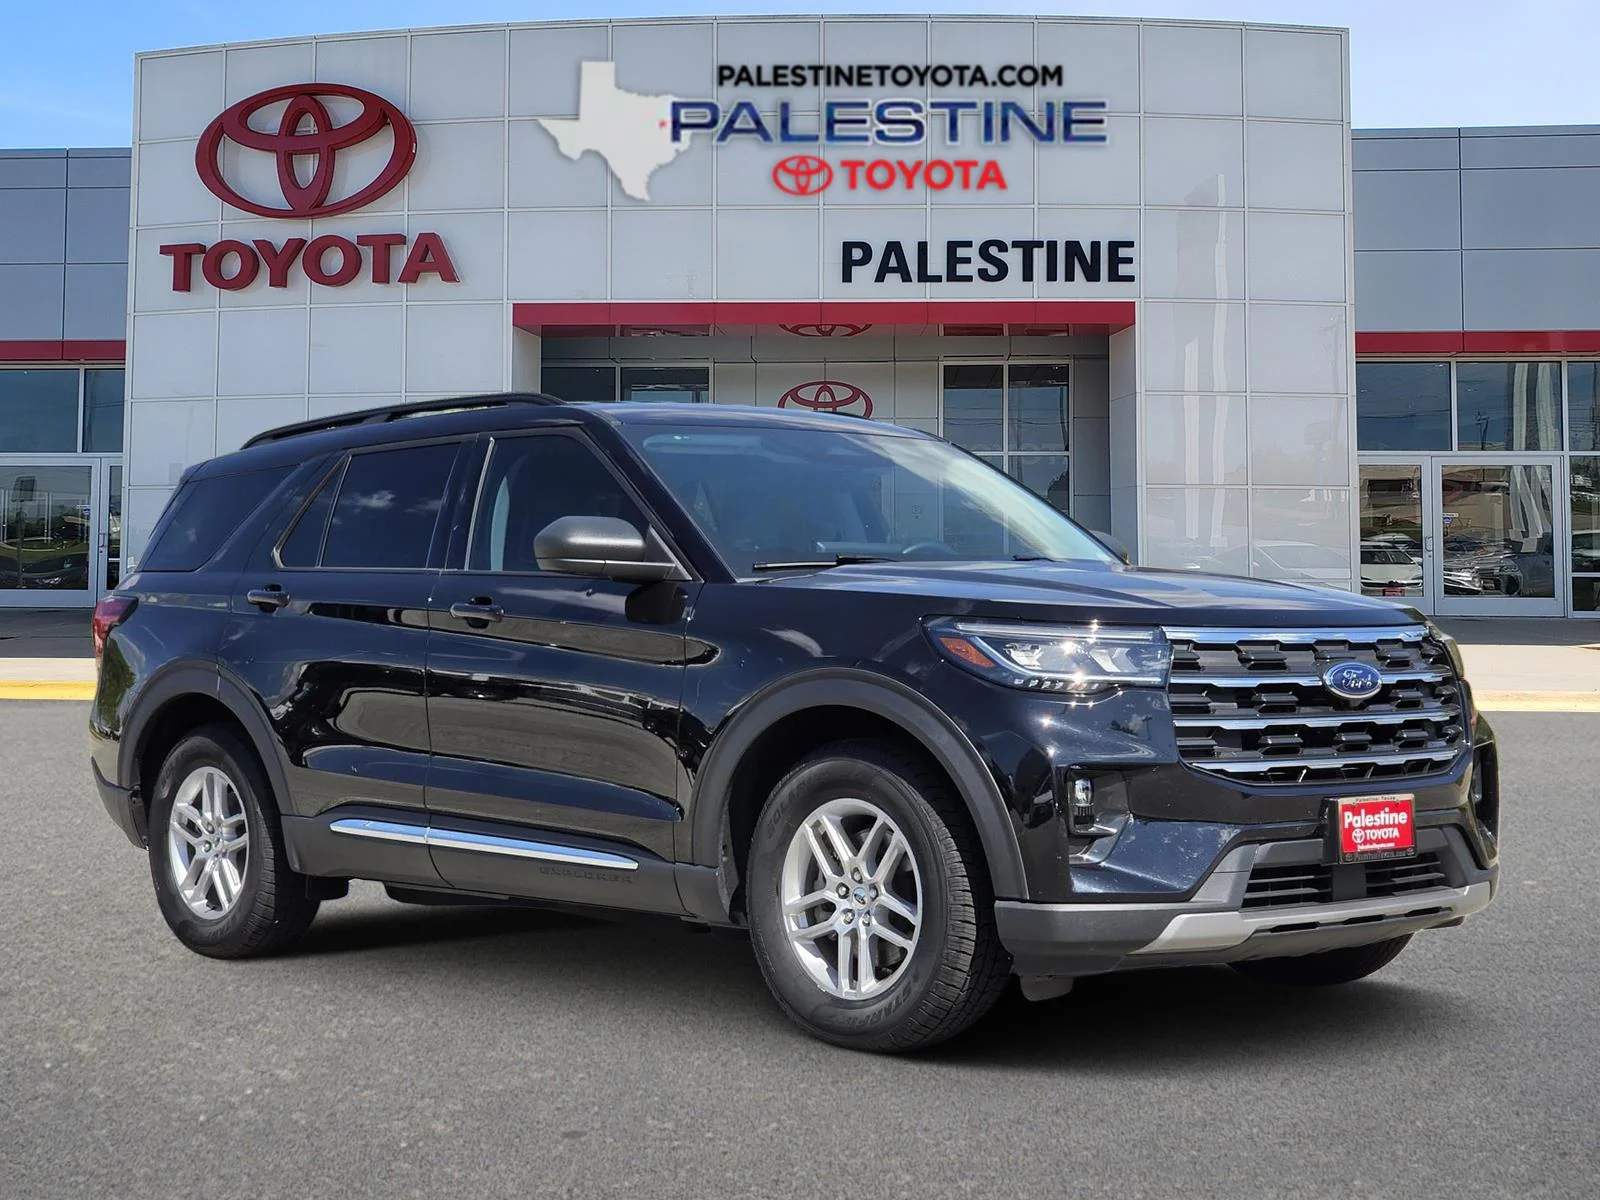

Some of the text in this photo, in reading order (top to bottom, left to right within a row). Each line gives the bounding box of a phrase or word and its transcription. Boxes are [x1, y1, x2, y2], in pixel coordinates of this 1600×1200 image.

[160, 232, 460, 292] TOYOTA
[841, 239, 1136, 284] PALESTINE
[1342, 669, 1373, 689] Ford
[1344, 807, 1408, 828] Palestine
[1365, 828, 1400, 840] TOYOTA
